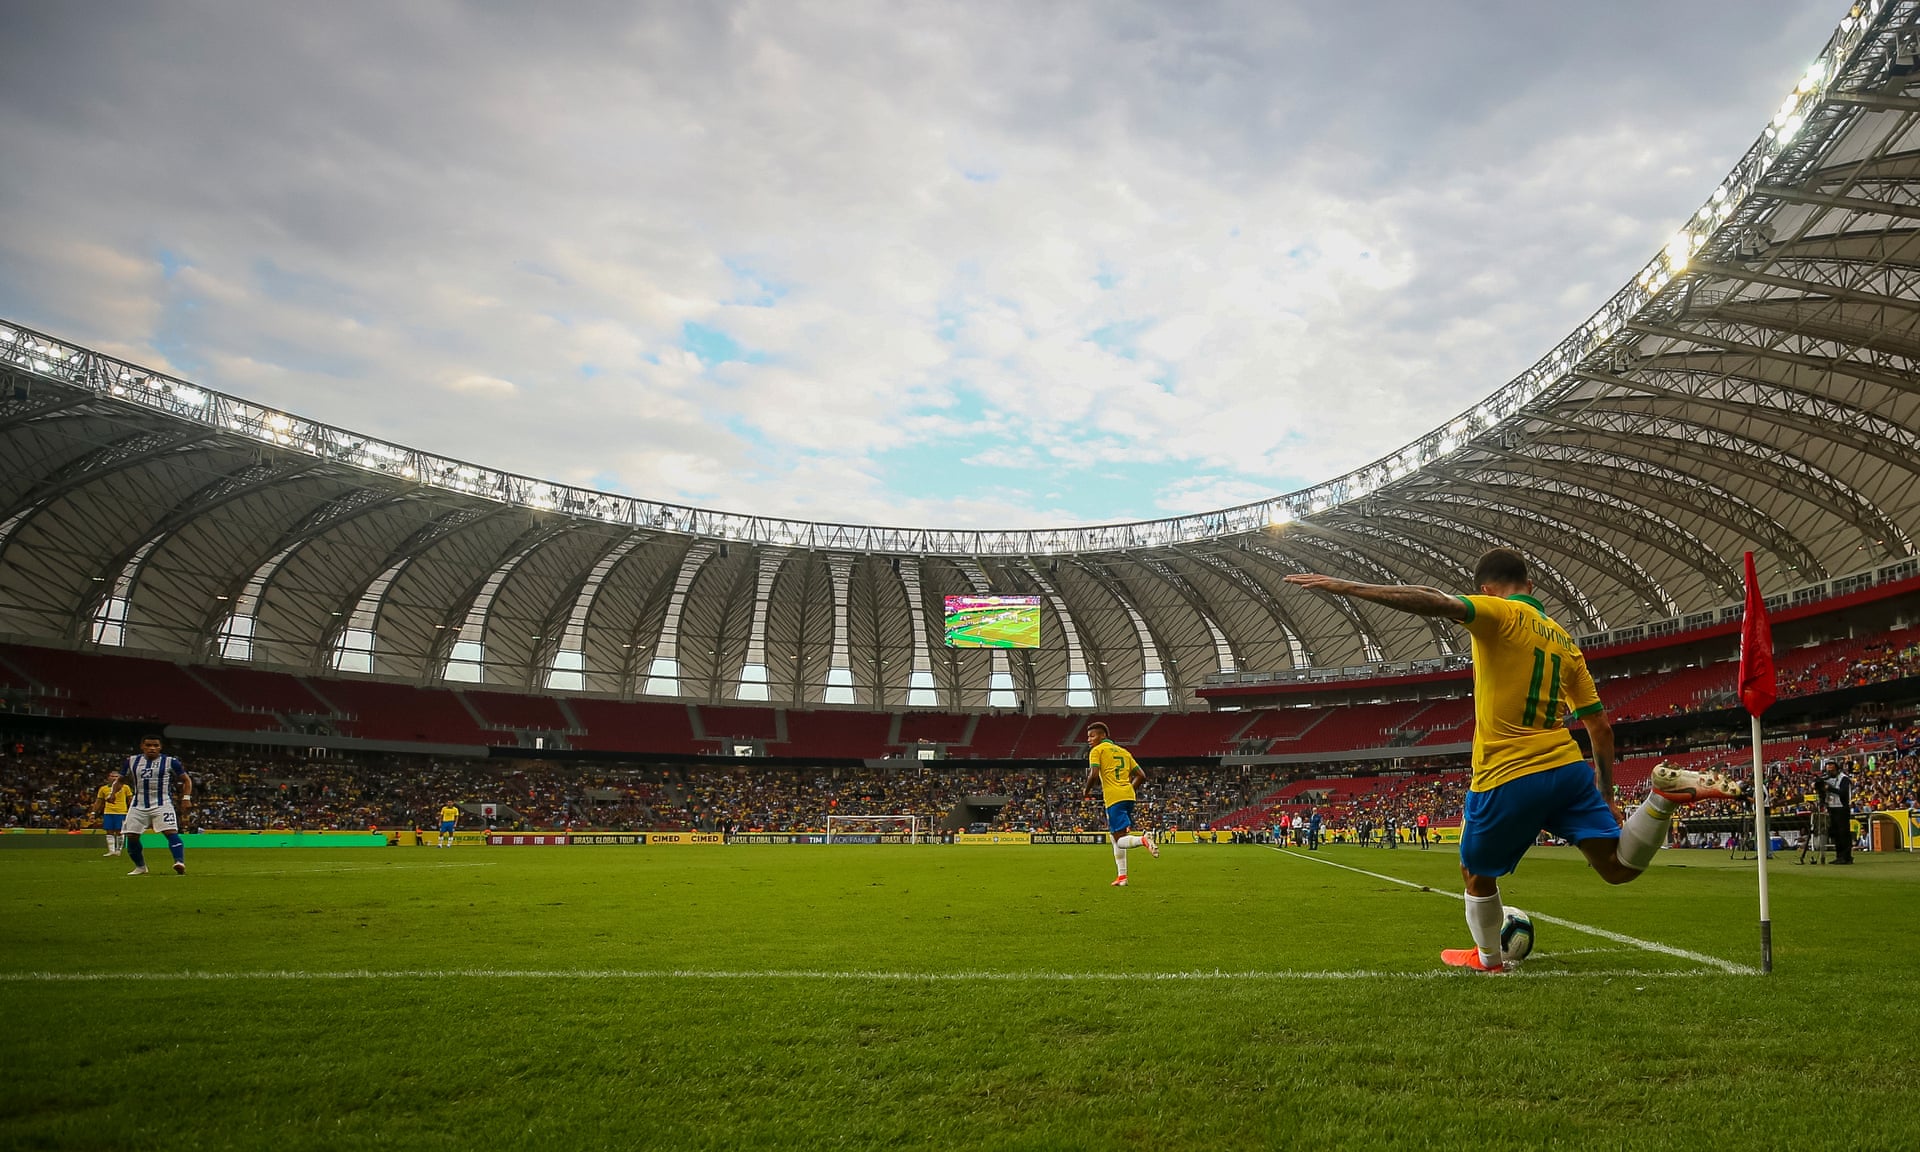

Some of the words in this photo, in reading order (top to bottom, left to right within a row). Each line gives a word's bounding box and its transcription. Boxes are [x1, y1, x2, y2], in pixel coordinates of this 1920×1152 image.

[1522, 646, 1561, 729] 11
[1112, 756, 1125, 780] 7
[141, 769, 153, 778] 23
[163, 813, 175, 822] 23
[573, 836, 594, 844] BRASIL
[595, 836, 618, 844] GLOBAL
[619, 836, 635, 844] TOUR
[691, 835, 719, 843] CIMED
[749, 836, 772, 844] GLOBAL
[773, 836, 789, 844] TOUR
[880, 836, 901, 844] BRASIL
[1055, 836, 1078, 844] GLOBAL
